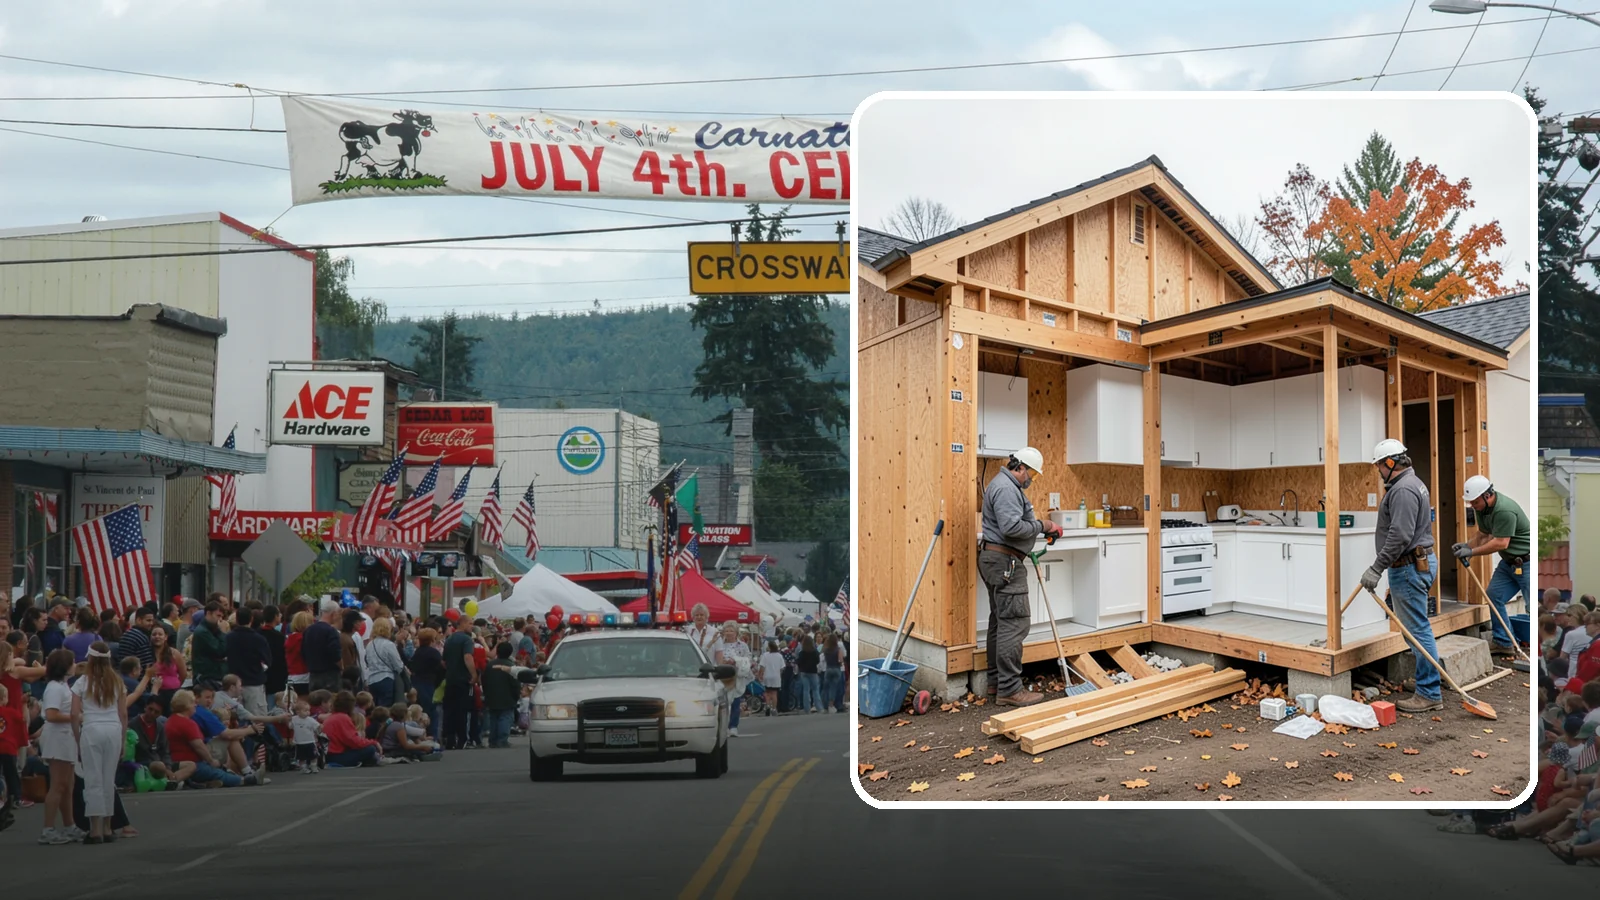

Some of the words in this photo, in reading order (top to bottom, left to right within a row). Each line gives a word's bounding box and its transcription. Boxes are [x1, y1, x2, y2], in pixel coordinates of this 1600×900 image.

[695, 121, 850, 150] Carnat
[481, 141, 605, 193] JULY
[632, 150, 746, 198] 4th.
[696, 254, 850, 280] CROSSWA
[282, 380, 374, 420] ACE
[405, 409, 452, 422] CEDAR
[283, 421, 371, 437] Hardware
[416, 428, 477, 447] Coca-Cola
[353, 467, 385, 479] Simpl
[95, 485, 124, 495] Vincent
[126, 485, 136, 495] de
[137, 486, 155, 496] Paul
[688, 526, 741, 535] CRNATION
[699, 535, 730, 543] GLASS
